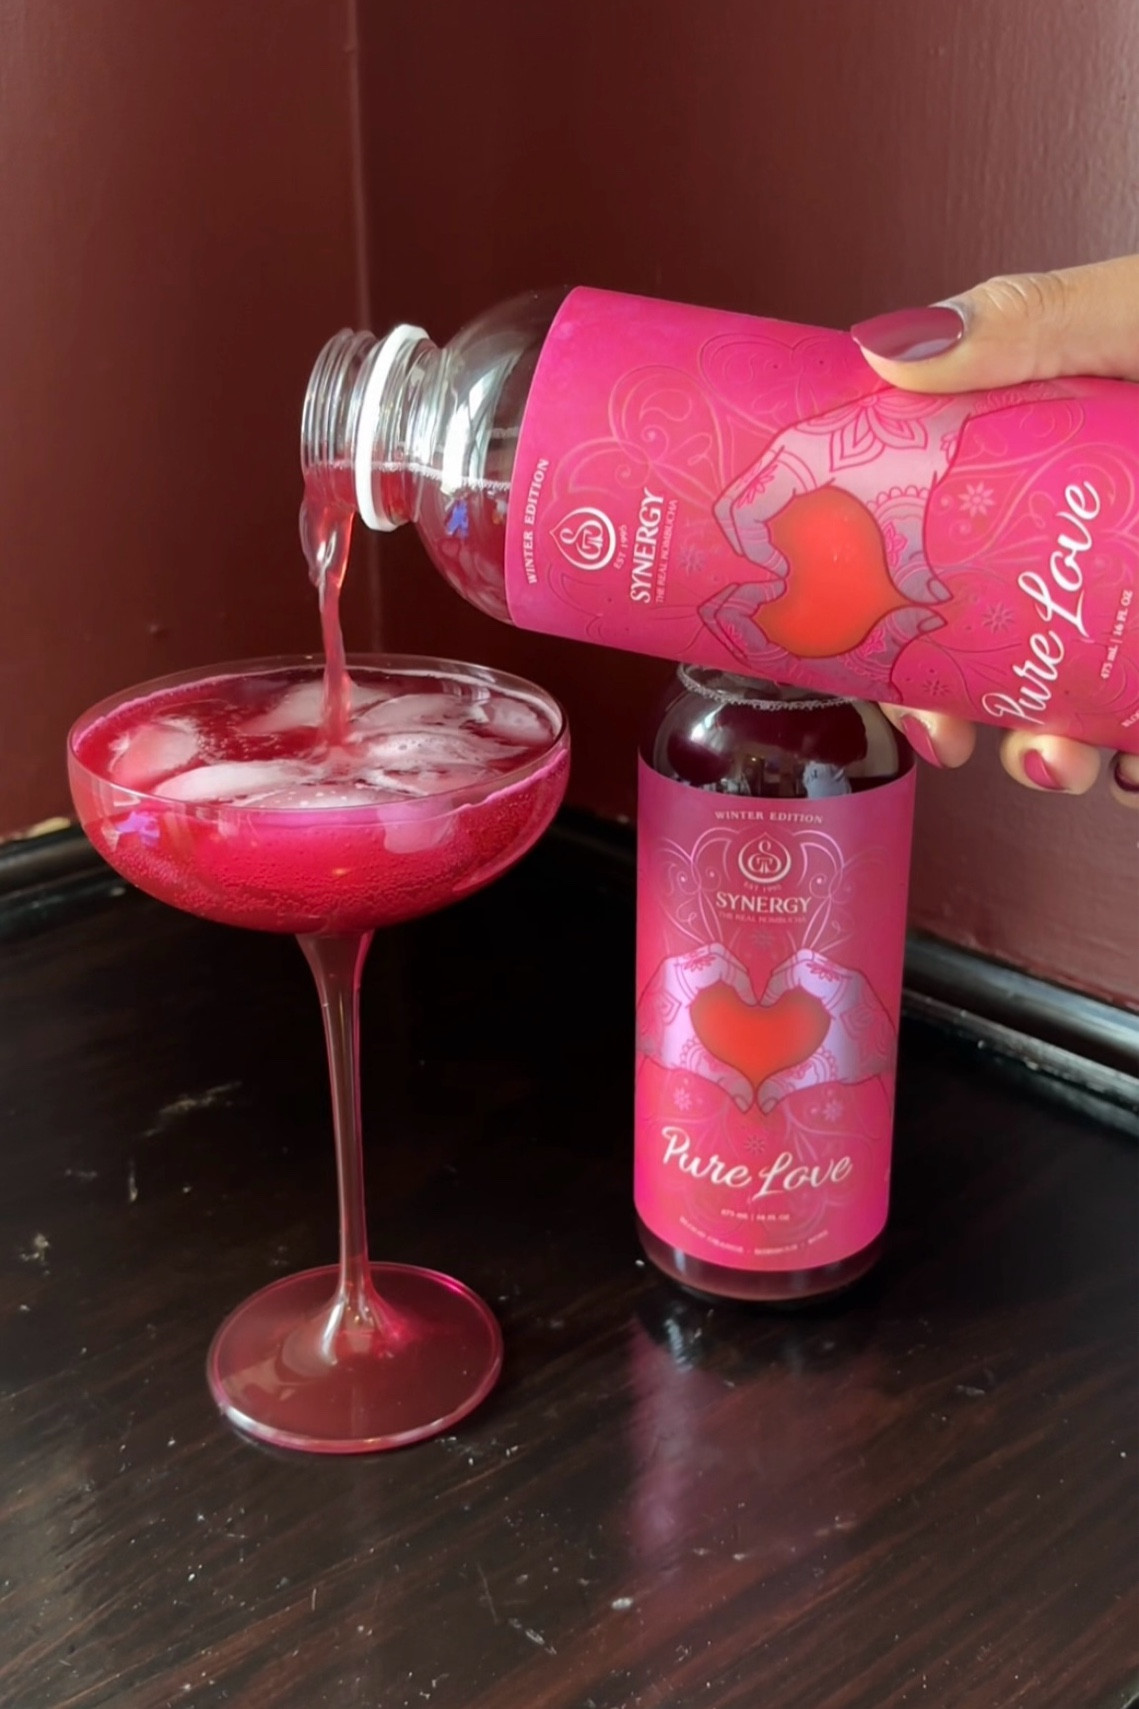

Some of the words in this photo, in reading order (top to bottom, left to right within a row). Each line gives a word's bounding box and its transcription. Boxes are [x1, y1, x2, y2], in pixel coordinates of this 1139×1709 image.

[524, 459, 550, 525] EDITION
[630, 487, 664, 604] SYNERGY
[661, 499, 678, 560] KOMBUCHA
[523, 531, 538, 584] WINTER
[613, 551, 627, 570] EST
[657, 563, 668, 586] REAL
[1018, 481, 1101, 638] Love
[656, 587, 665, 604] THE
[1121, 589, 1133, 607] OZ
[982, 630, 1065, 725] Pure
[714, 811, 764, 820] WINTER
[769, 811, 824, 824] EDITION
[716, 891, 812, 914] SYNERGY
[661, 1126, 752, 1188] Pure
[747, 1152, 853, 1204] Love
